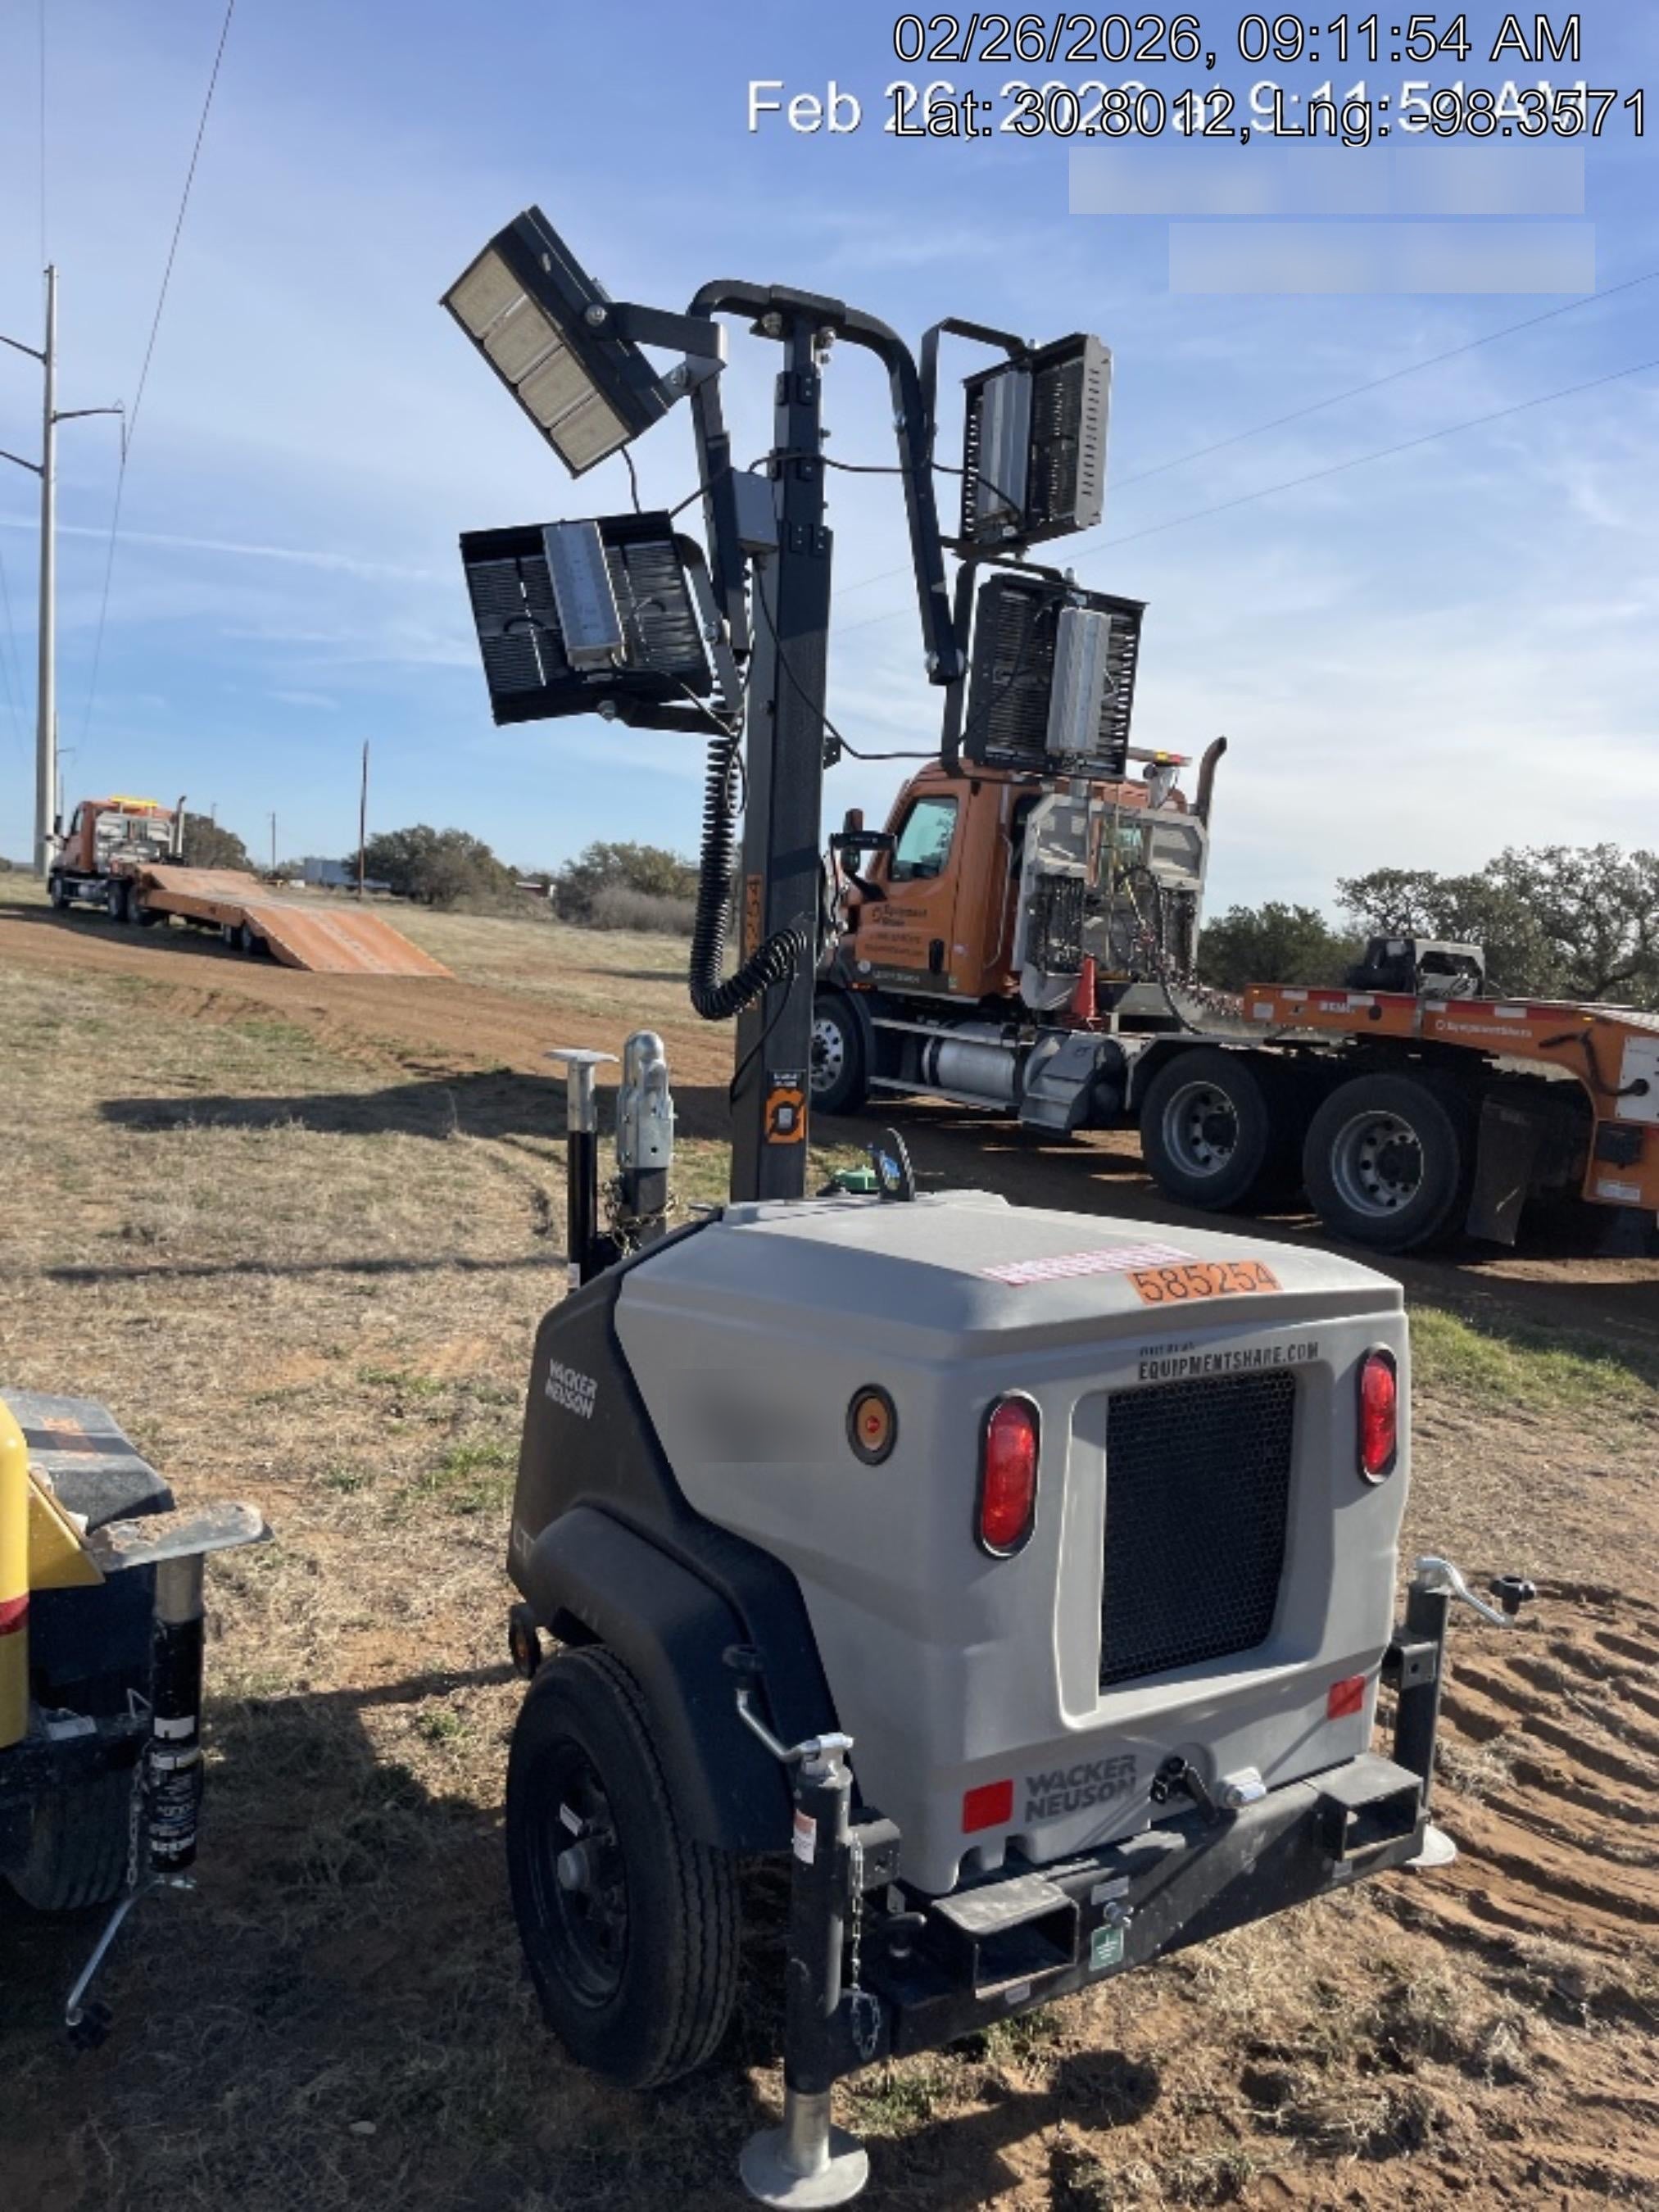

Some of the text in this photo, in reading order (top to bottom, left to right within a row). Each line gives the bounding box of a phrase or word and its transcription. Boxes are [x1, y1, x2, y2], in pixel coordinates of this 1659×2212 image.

[1134, 1262, 1279, 1302] 585254
[550, 1358, 597, 1399] WACKER
[1137, 1341, 1319, 1382] EQUIPMENTSHARE.COM
[545, 1378, 595, 1420] NEUSON
[1026, 1754, 1136, 1797] WACKER
[1025, 1775, 1136, 1823] NEUSON
